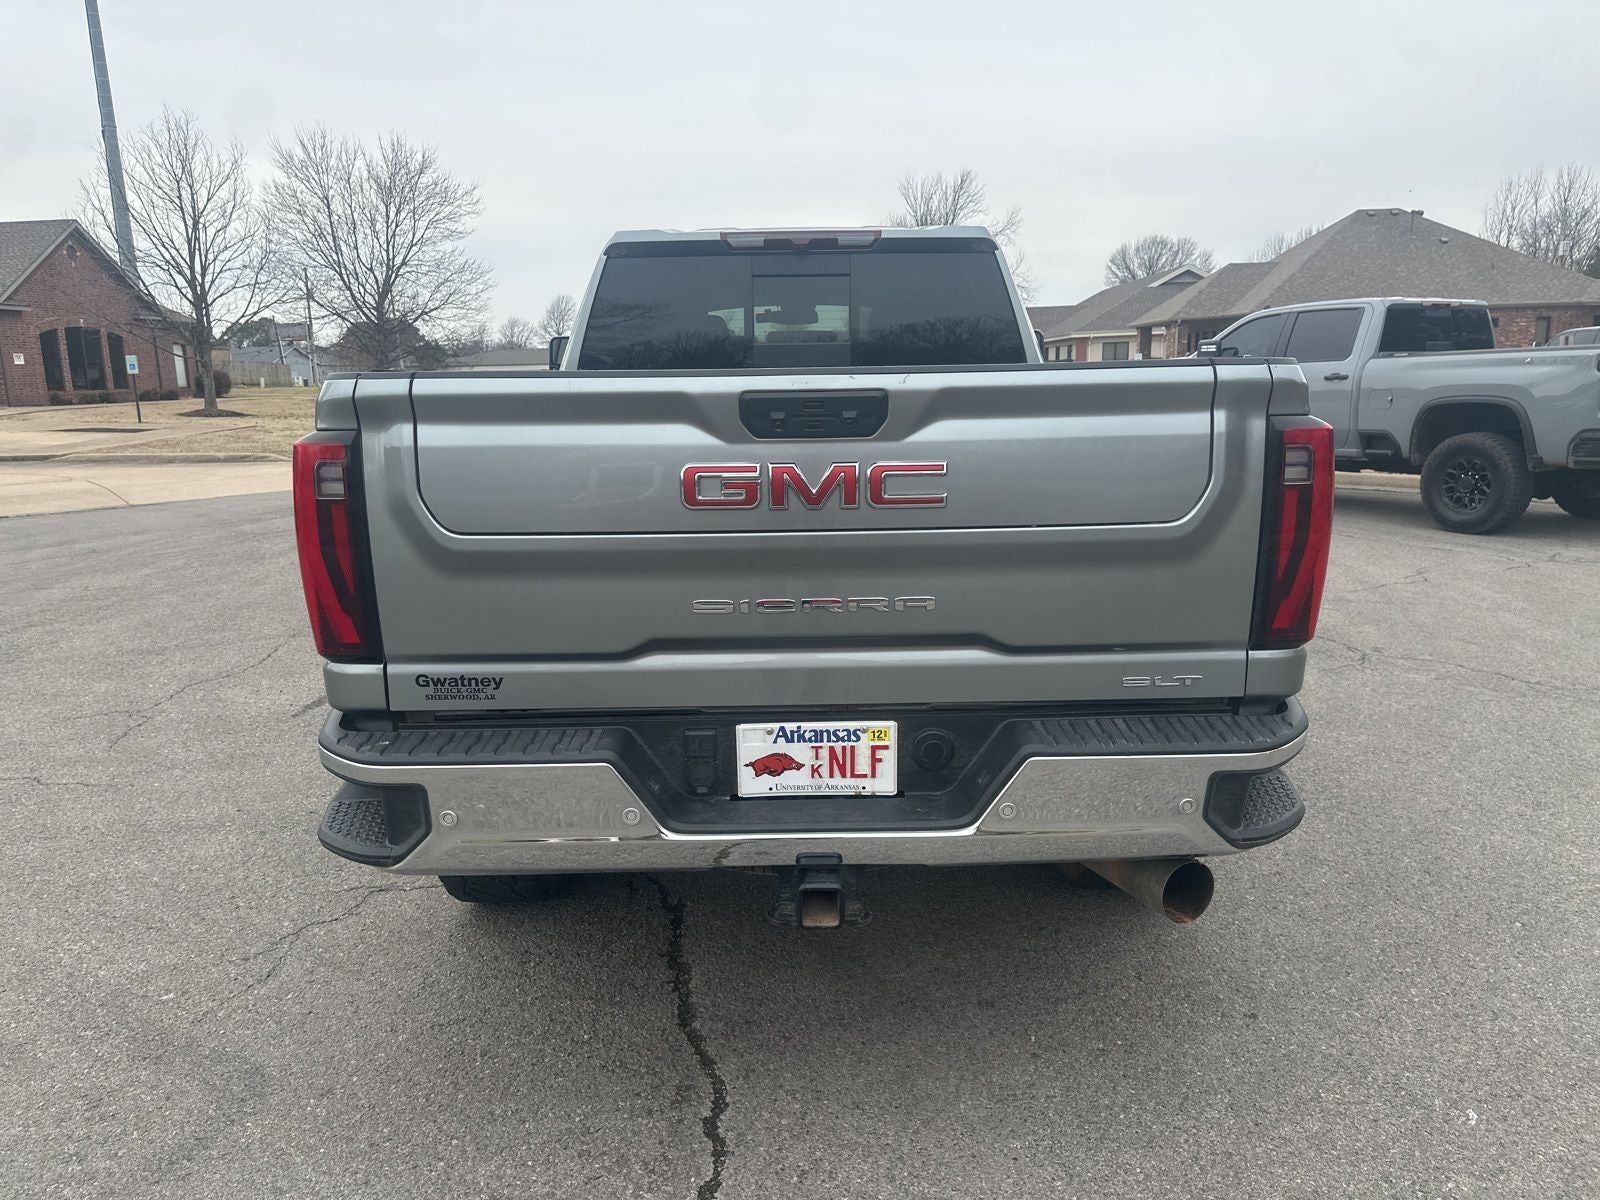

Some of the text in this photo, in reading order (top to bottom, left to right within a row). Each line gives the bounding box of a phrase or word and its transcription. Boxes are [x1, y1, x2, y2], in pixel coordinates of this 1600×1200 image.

[680, 461, 947, 510] GMC
[693, 596, 937, 614] SIERRA
[415, 674, 504, 691] Gwatney
[1122, 675, 1203, 687] SLT
[425, 693, 482, 701] SHERWOOD,
[772, 725, 862, 744] Arkansas
[870, 730, 883, 739] 12
